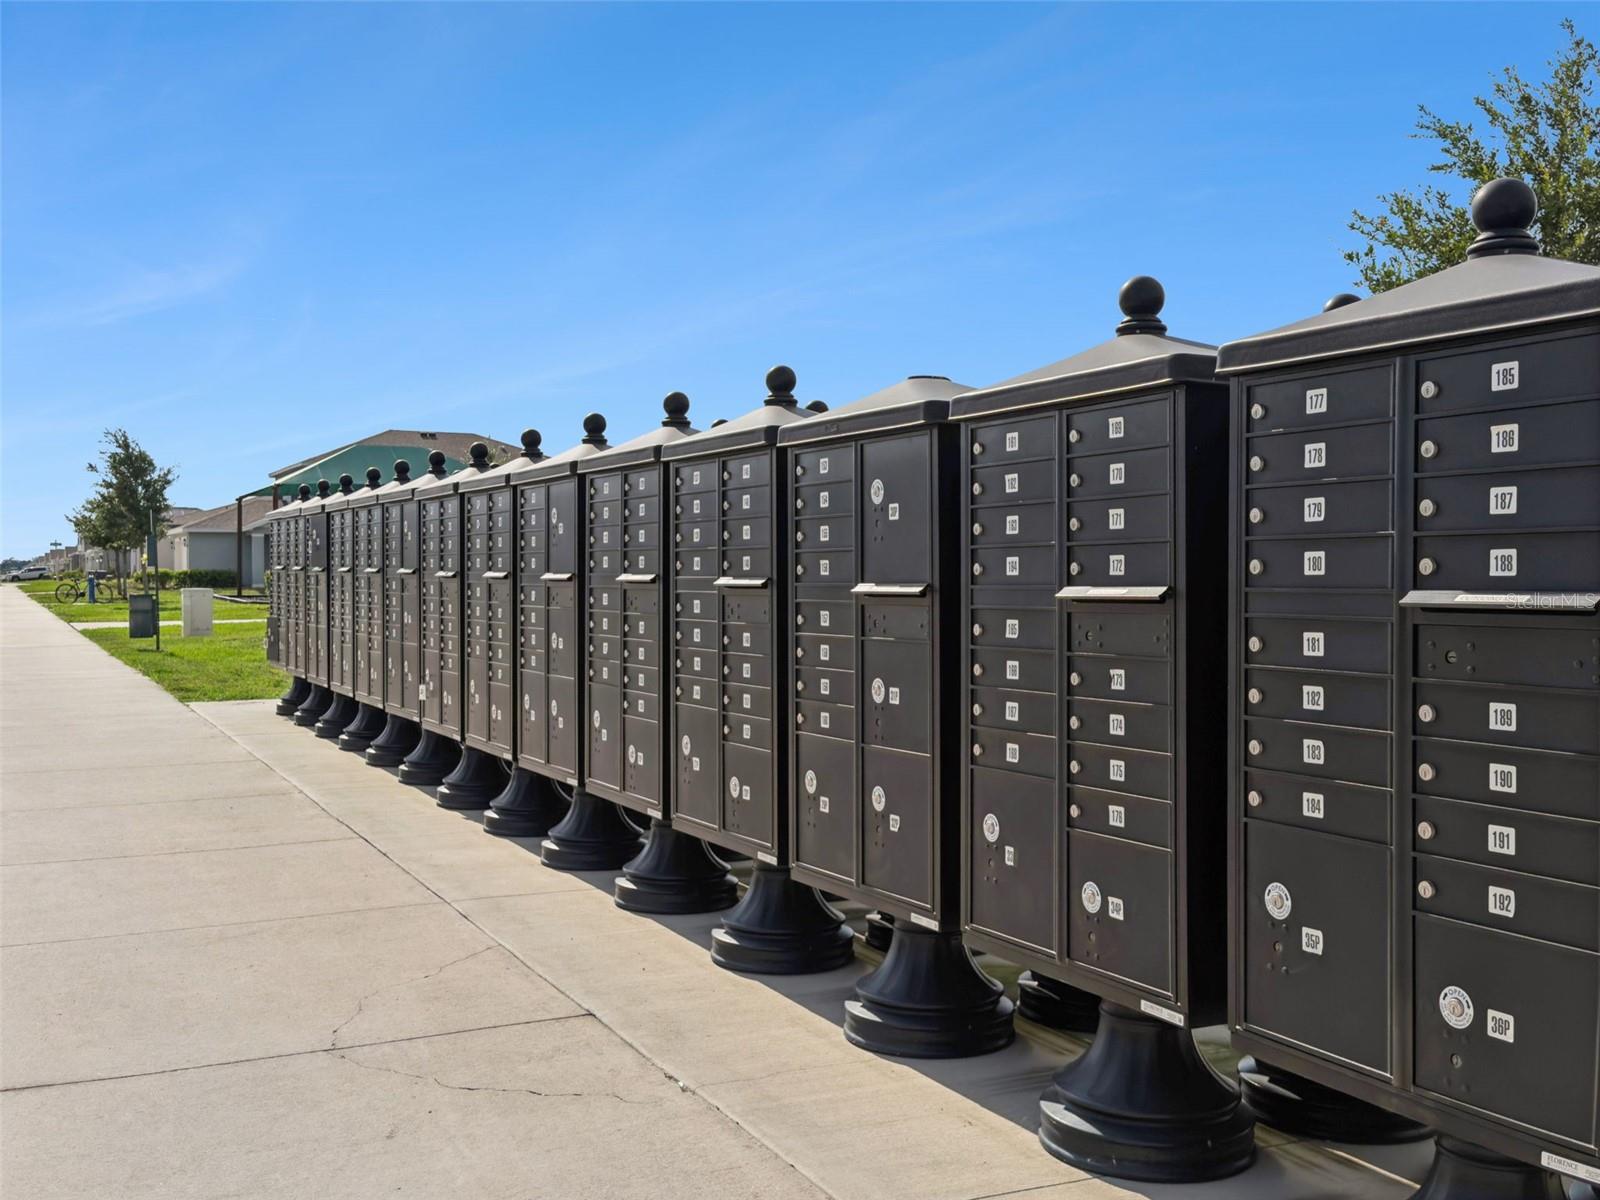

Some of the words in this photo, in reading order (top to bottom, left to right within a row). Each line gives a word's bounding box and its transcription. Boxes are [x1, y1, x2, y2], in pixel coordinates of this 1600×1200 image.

[1496, 367, 1515, 386] 185
[1309, 393, 1324, 410] 177
[1496, 429, 1515, 448] 186
[1308, 447, 1323, 464] 178
[1112, 467, 1123, 481] 170
[1494, 492, 1513, 510] 187
[1307, 502, 1322, 518] 179
[1111, 512, 1122, 526] 171
[1112, 558, 1123, 572] 172
[1307, 556, 1322, 572] 180
[1494, 554, 1513, 572] 188
[1306, 636, 1320, 653] 181
[1111, 673, 1123, 687] 173
[1306, 690, 1321, 706] 182
[1112, 718, 1123, 732] 174
[1493, 708, 1512, 727] 189
[1306, 744, 1322, 761] 183
[1112, 764, 1123, 778] 175
[1494, 769, 1513, 789] 190
[1306, 798, 1321, 814] 184
[1492, 831, 1510, 850] 191
[1492, 892, 1512, 913] 192
[1305, 932, 1320, 950] 35P
[1447, 988, 1467, 1000] OPEN
[1491, 1016, 1510, 1036] 36P
[1546, 1155, 1577, 1170] FLORENCE
